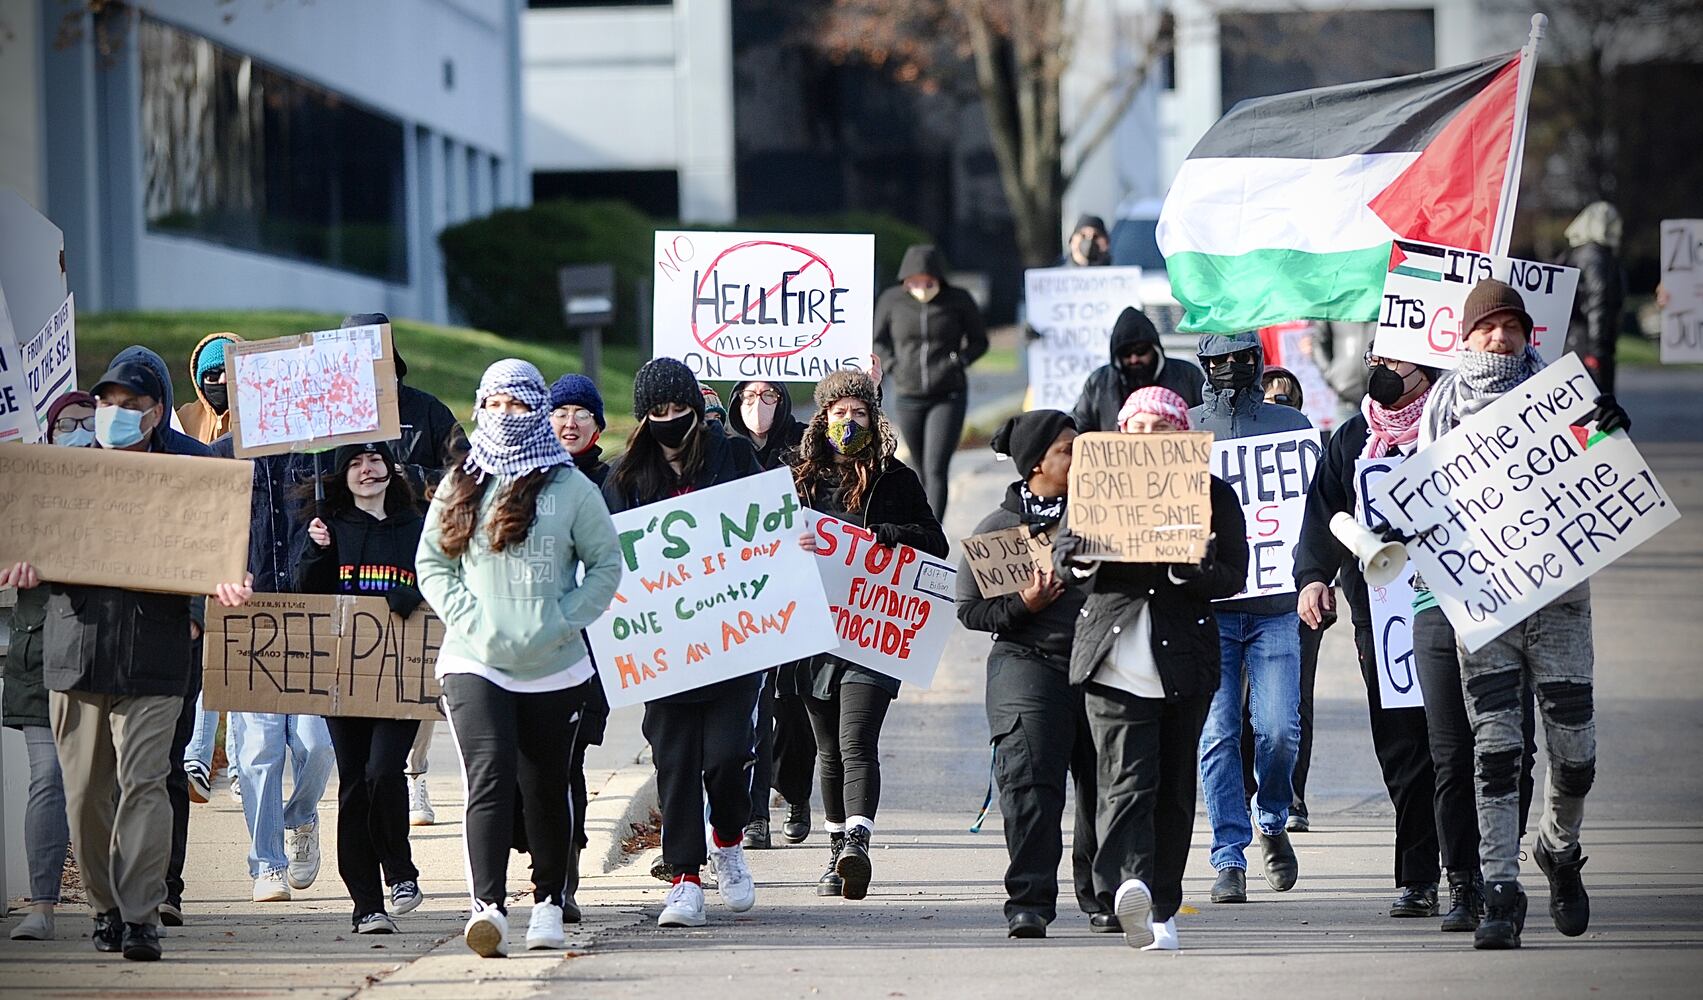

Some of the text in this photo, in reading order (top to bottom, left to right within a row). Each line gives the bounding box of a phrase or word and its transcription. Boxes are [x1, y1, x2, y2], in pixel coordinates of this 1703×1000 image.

[659, 235, 695, 282] NO
[1509, 261, 1565, 294] NOT
[27, 302, 69, 363] FROM THE RIVER
[715, 333, 822, 351] MISSILES
[28, 329, 71, 395] TO THE SEA
[684, 352, 722, 377] ON
[0, 457, 89, 479] BOMBING
[1079, 439, 1210, 468] AMERICA BACKS
[1389, 373, 1585, 522] From the river
[1076, 470, 1209, 499] ISRAEL B/C WE
[1414, 434, 1578, 554] to the sea
[1074, 503, 1201, 526] DID THE SAME
[1437, 462, 1618, 587] Palestine
[815, 517, 917, 586] STOP
[963, 540, 990, 561] NO
[1464, 469, 1666, 623] will be FREE!
[640, 564, 693, 594] WAR
[702, 552, 726, 576] IF
[976, 567, 1004, 590] NO
[612, 611, 662, 641] ONE
[614, 601, 797, 690] HAS AN ARMY
[223, 612, 331, 696] FREE
